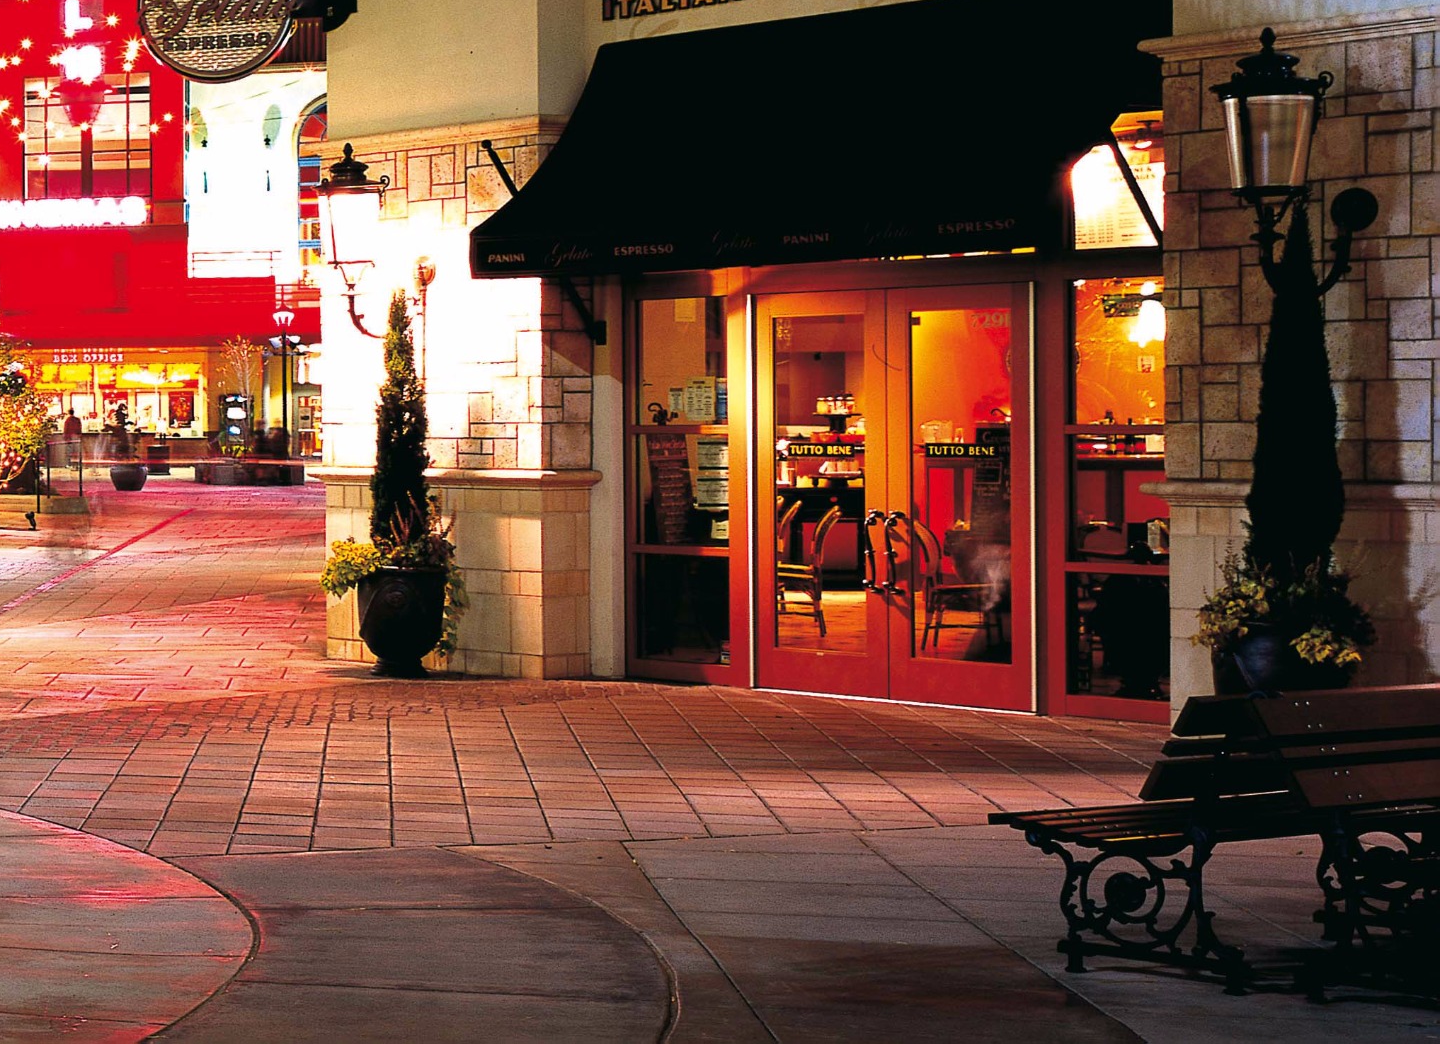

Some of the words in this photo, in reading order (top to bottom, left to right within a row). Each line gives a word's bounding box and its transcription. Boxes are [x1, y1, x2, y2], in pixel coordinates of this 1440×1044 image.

[163, 31, 271, 51] ESPRESSO
[487, 252, 525, 264] PANINI
[614, 243, 674, 257] ESPRESSO
[783, 232, 831, 245] PANINI
[937, 218, 1016, 235] ESPRESSO
[52, 353, 77, 363] BOX
[82, 353, 124, 363] OFFICE
[789, 444, 824, 455] TUTTO
[826, 444, 853, 455] BENE
[928, 445, 965, 456] TUTTO
[968, 444, 996, 456] BENE
